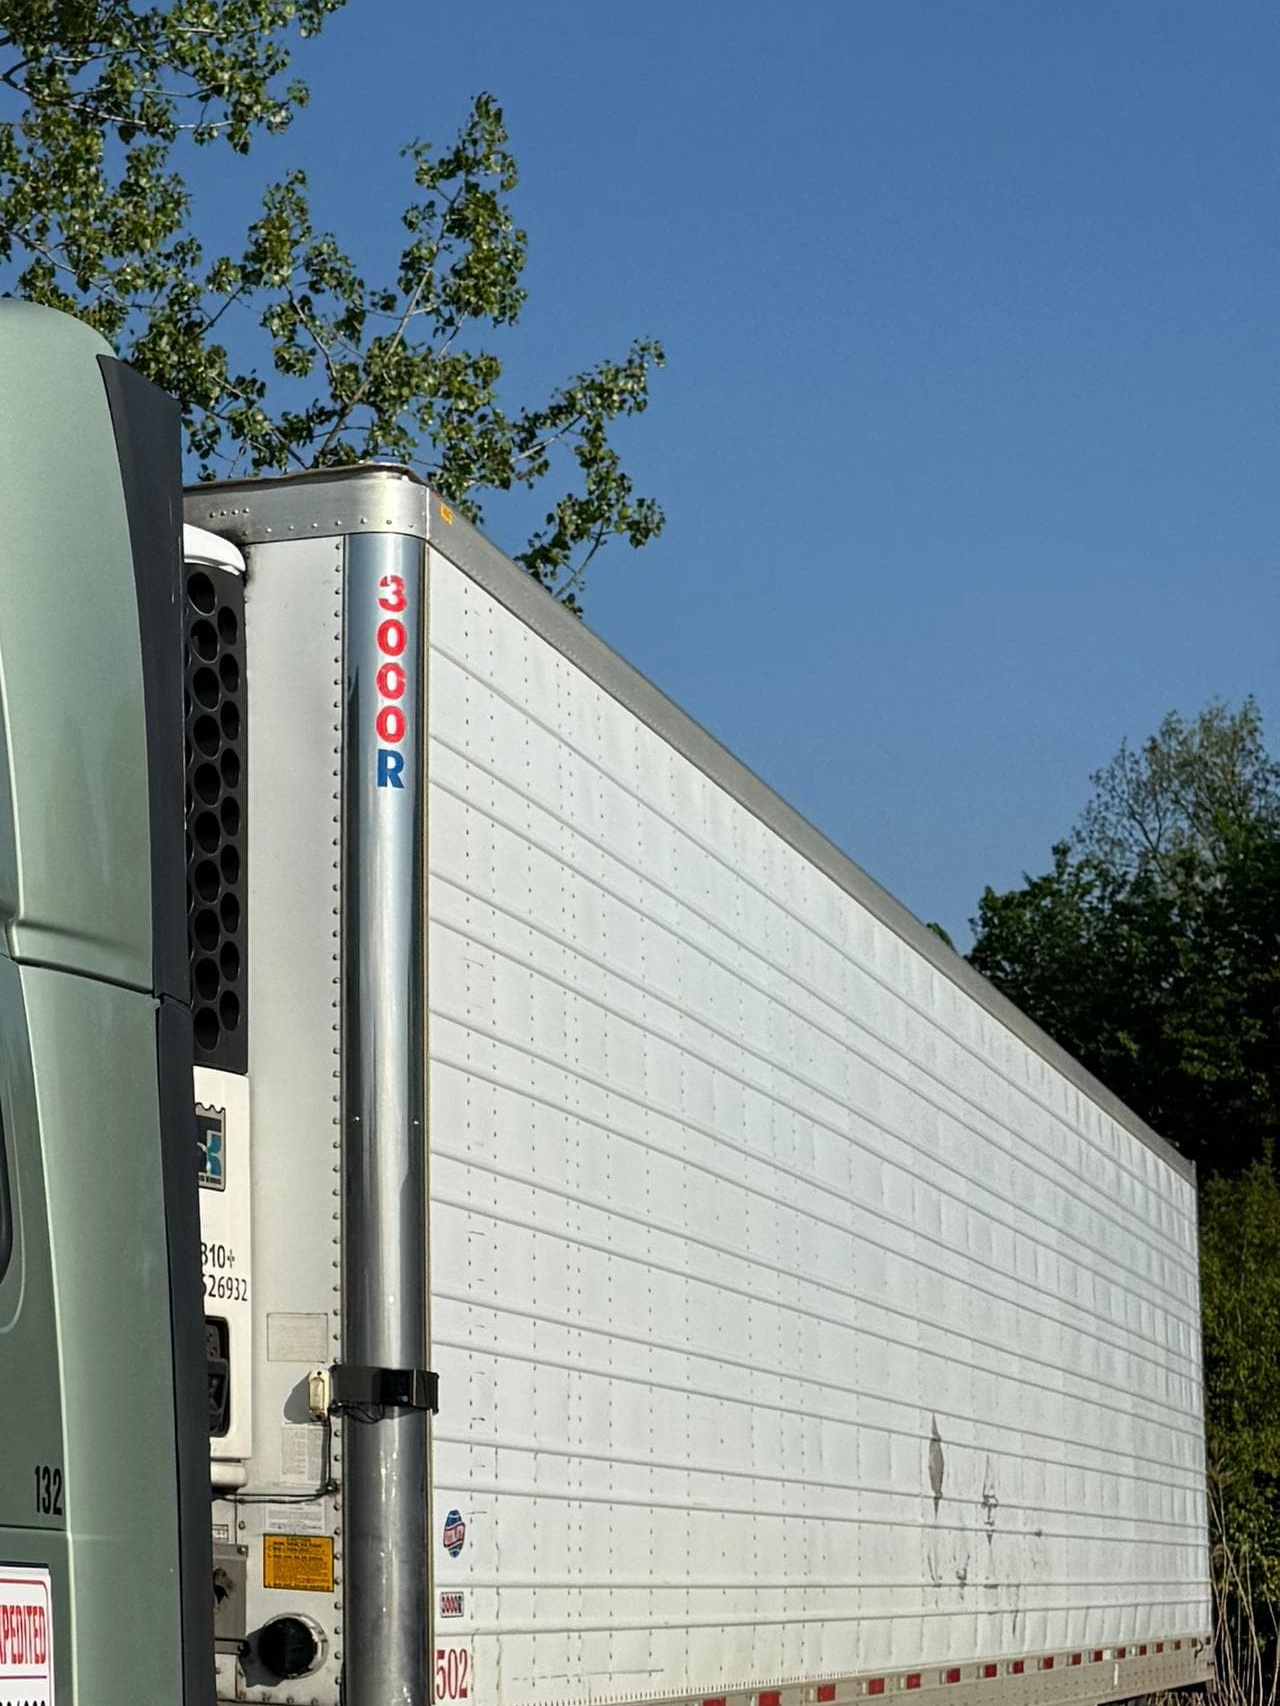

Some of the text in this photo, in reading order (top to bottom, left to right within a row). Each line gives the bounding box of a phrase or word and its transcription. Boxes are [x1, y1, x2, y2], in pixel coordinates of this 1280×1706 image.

[376, 575, 407, 789] 3000R
[35, 1465, 63, 1516] 132
[436, 1648, 468, 1700] 502
